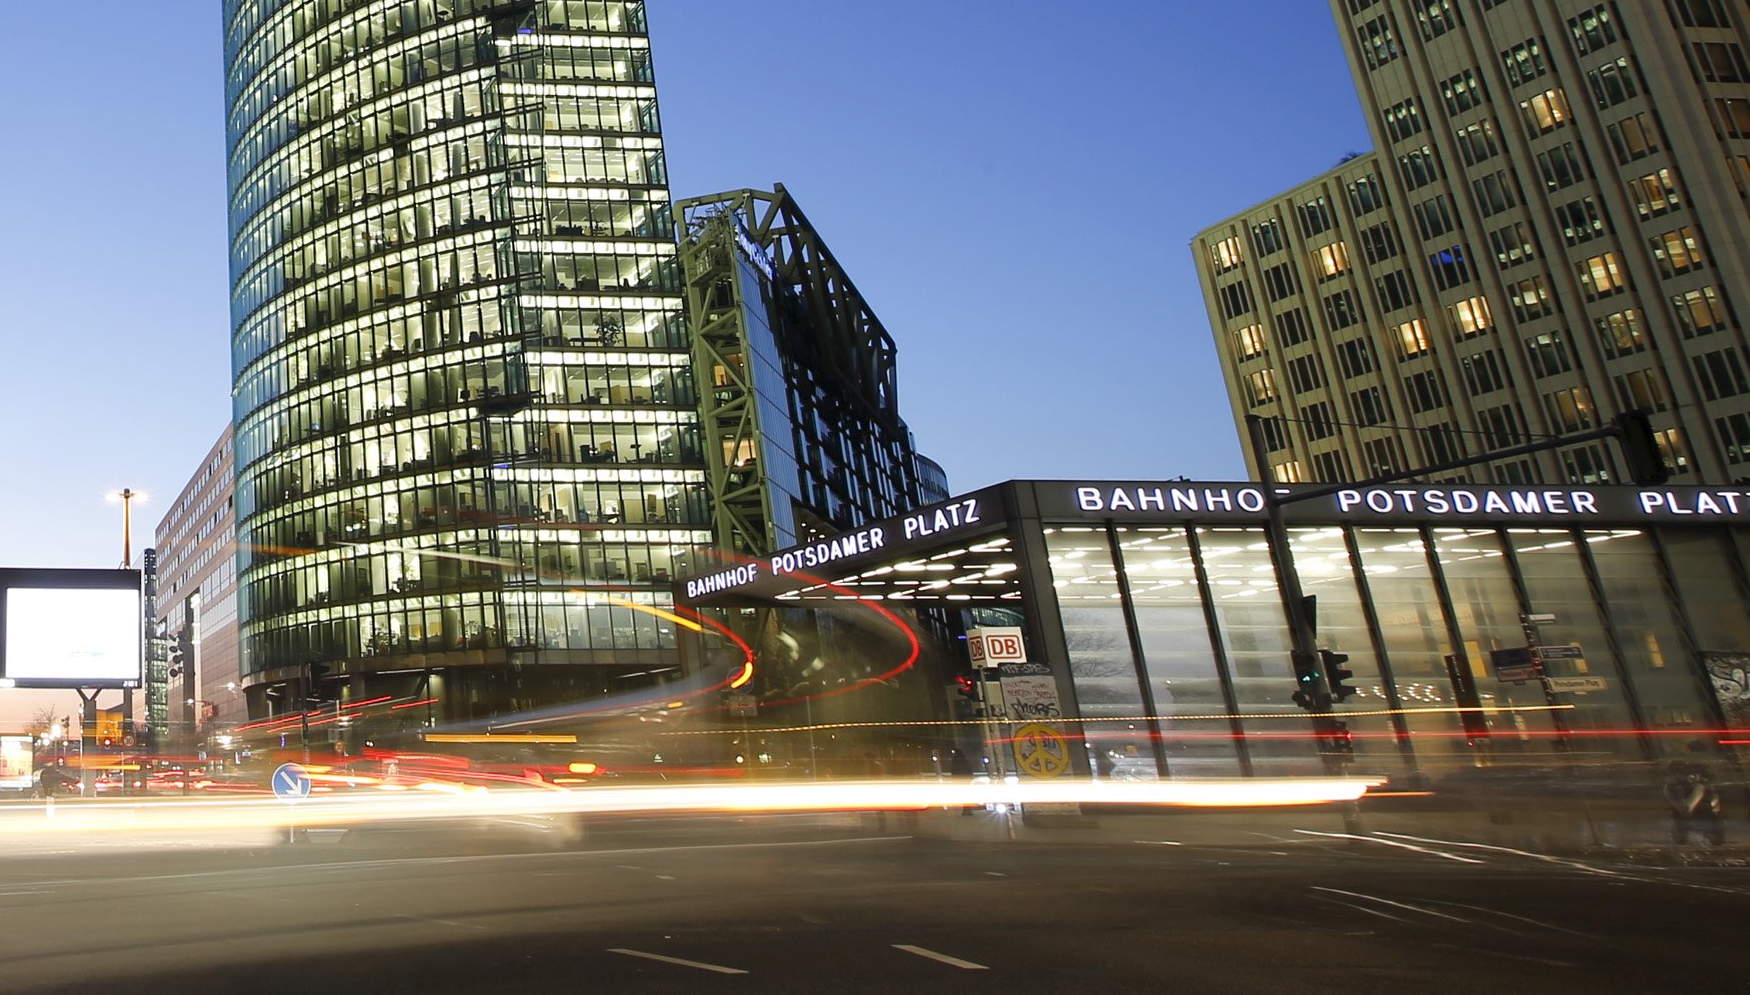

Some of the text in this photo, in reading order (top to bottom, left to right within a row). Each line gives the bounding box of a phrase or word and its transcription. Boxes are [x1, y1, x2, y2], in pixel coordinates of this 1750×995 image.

[1337, 489, 1599, 514] POTSDAMER
[1640, 491, 1750, 514] PLAT
[687, 498, 980, 600] BAHNHOF POTSDAMER PLATZ
[970, 640, 983, 657] DB
[990, 638, 1018, 655] DB
